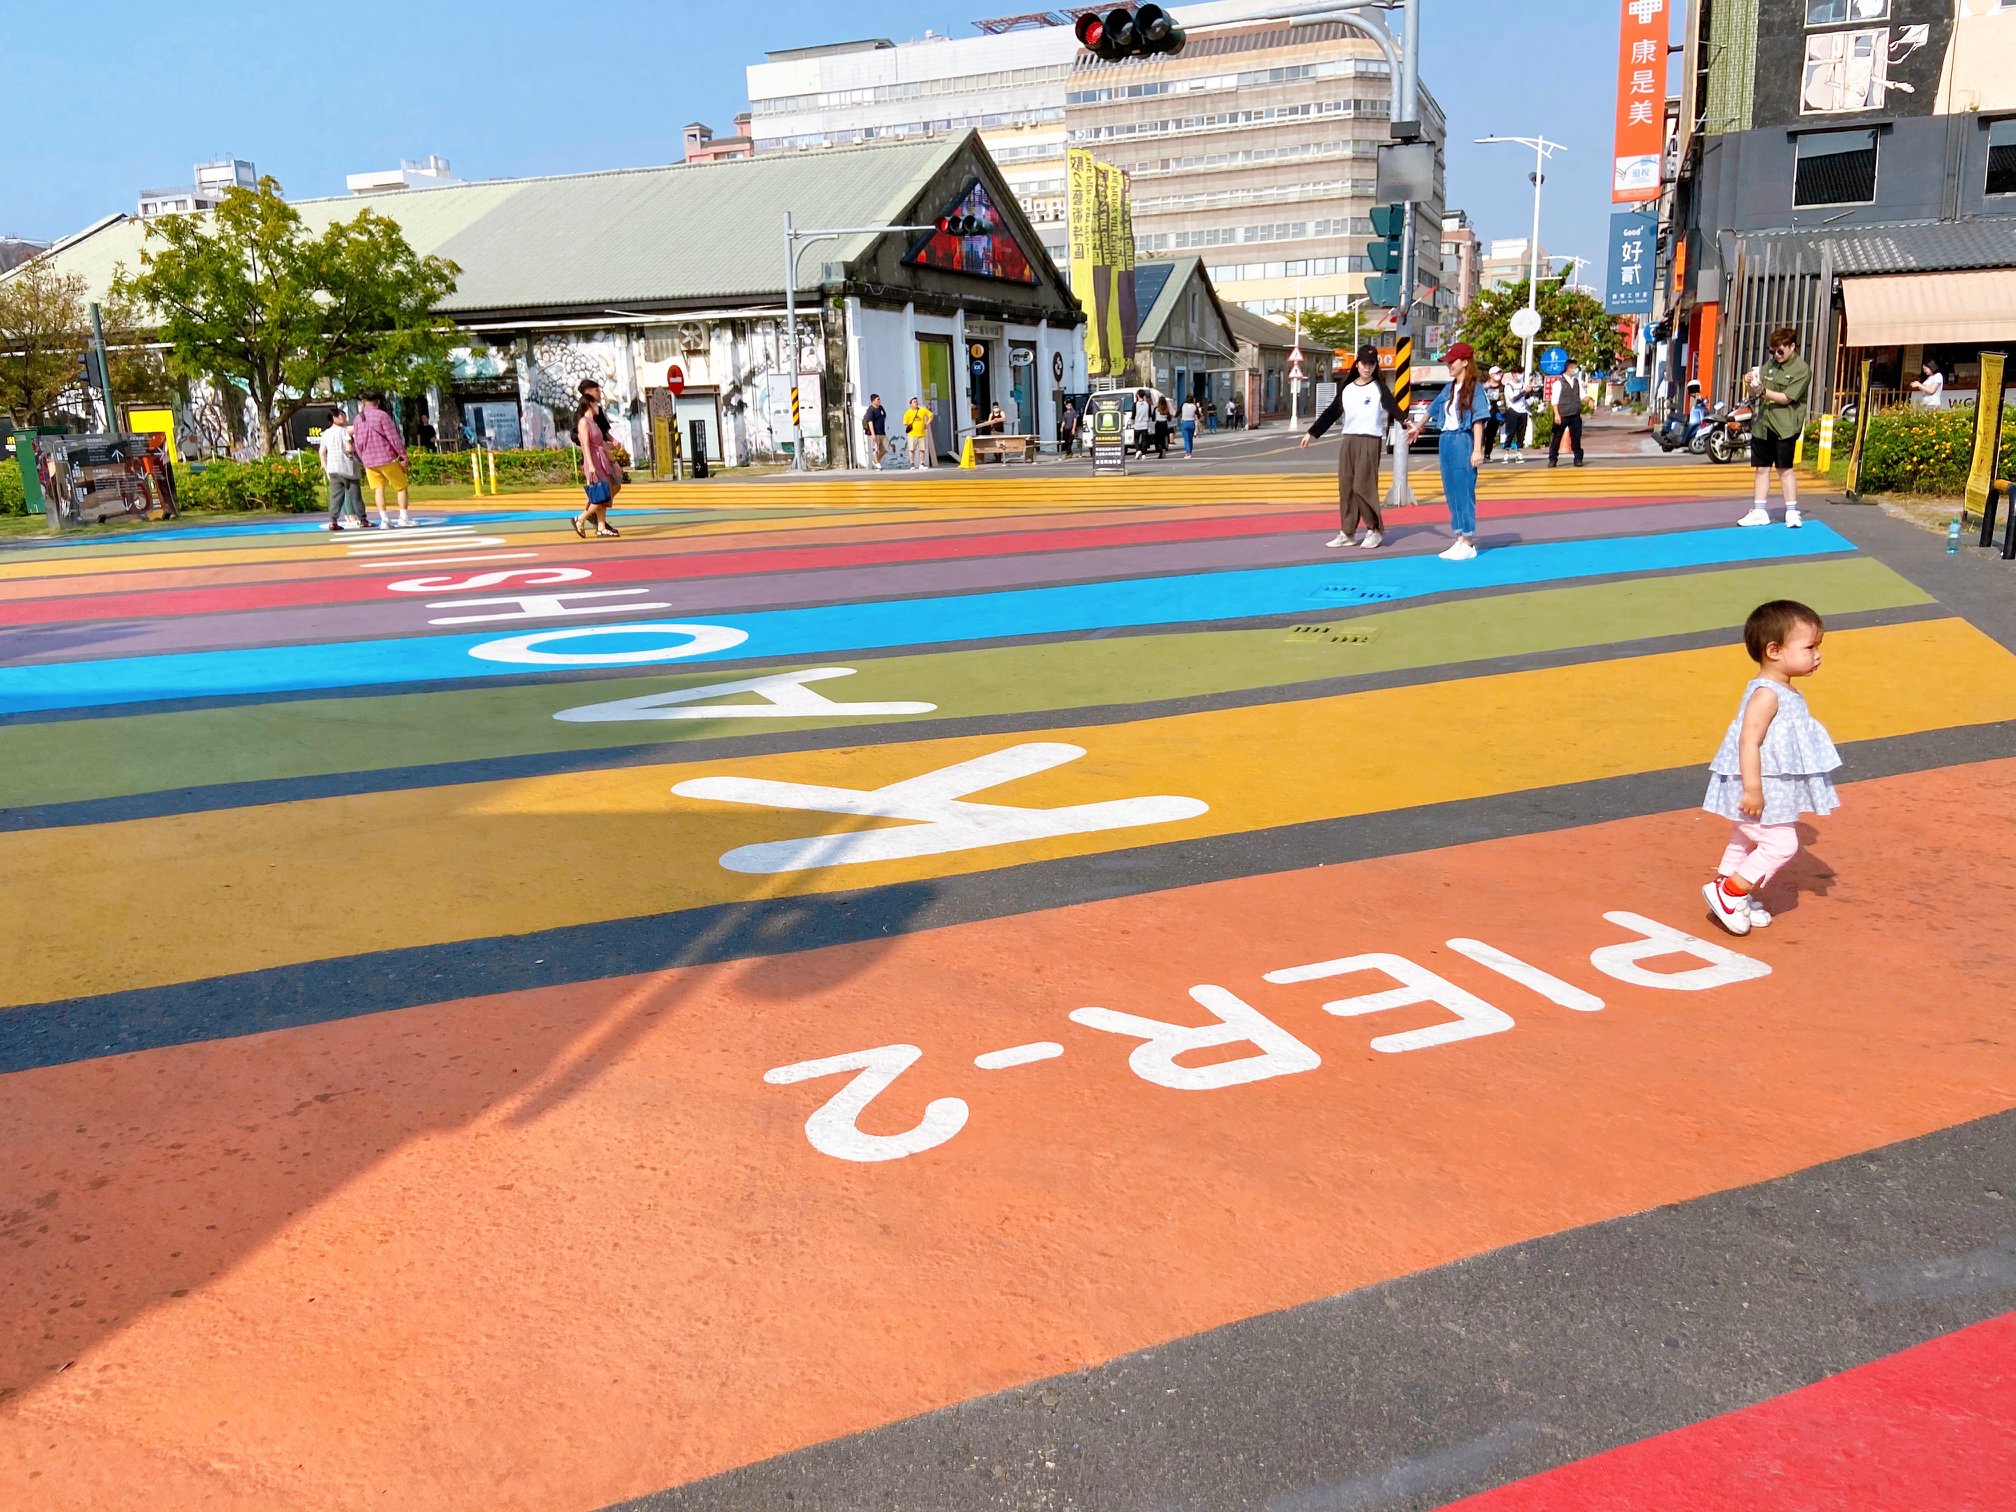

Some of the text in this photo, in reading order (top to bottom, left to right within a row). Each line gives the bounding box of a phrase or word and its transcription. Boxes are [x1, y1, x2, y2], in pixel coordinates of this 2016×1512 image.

[1629, 39, 1657, 126] 康是美
[1621, 241, 1644, 286] 好貳
[763, 911, 1772, 1162] PIER-2
